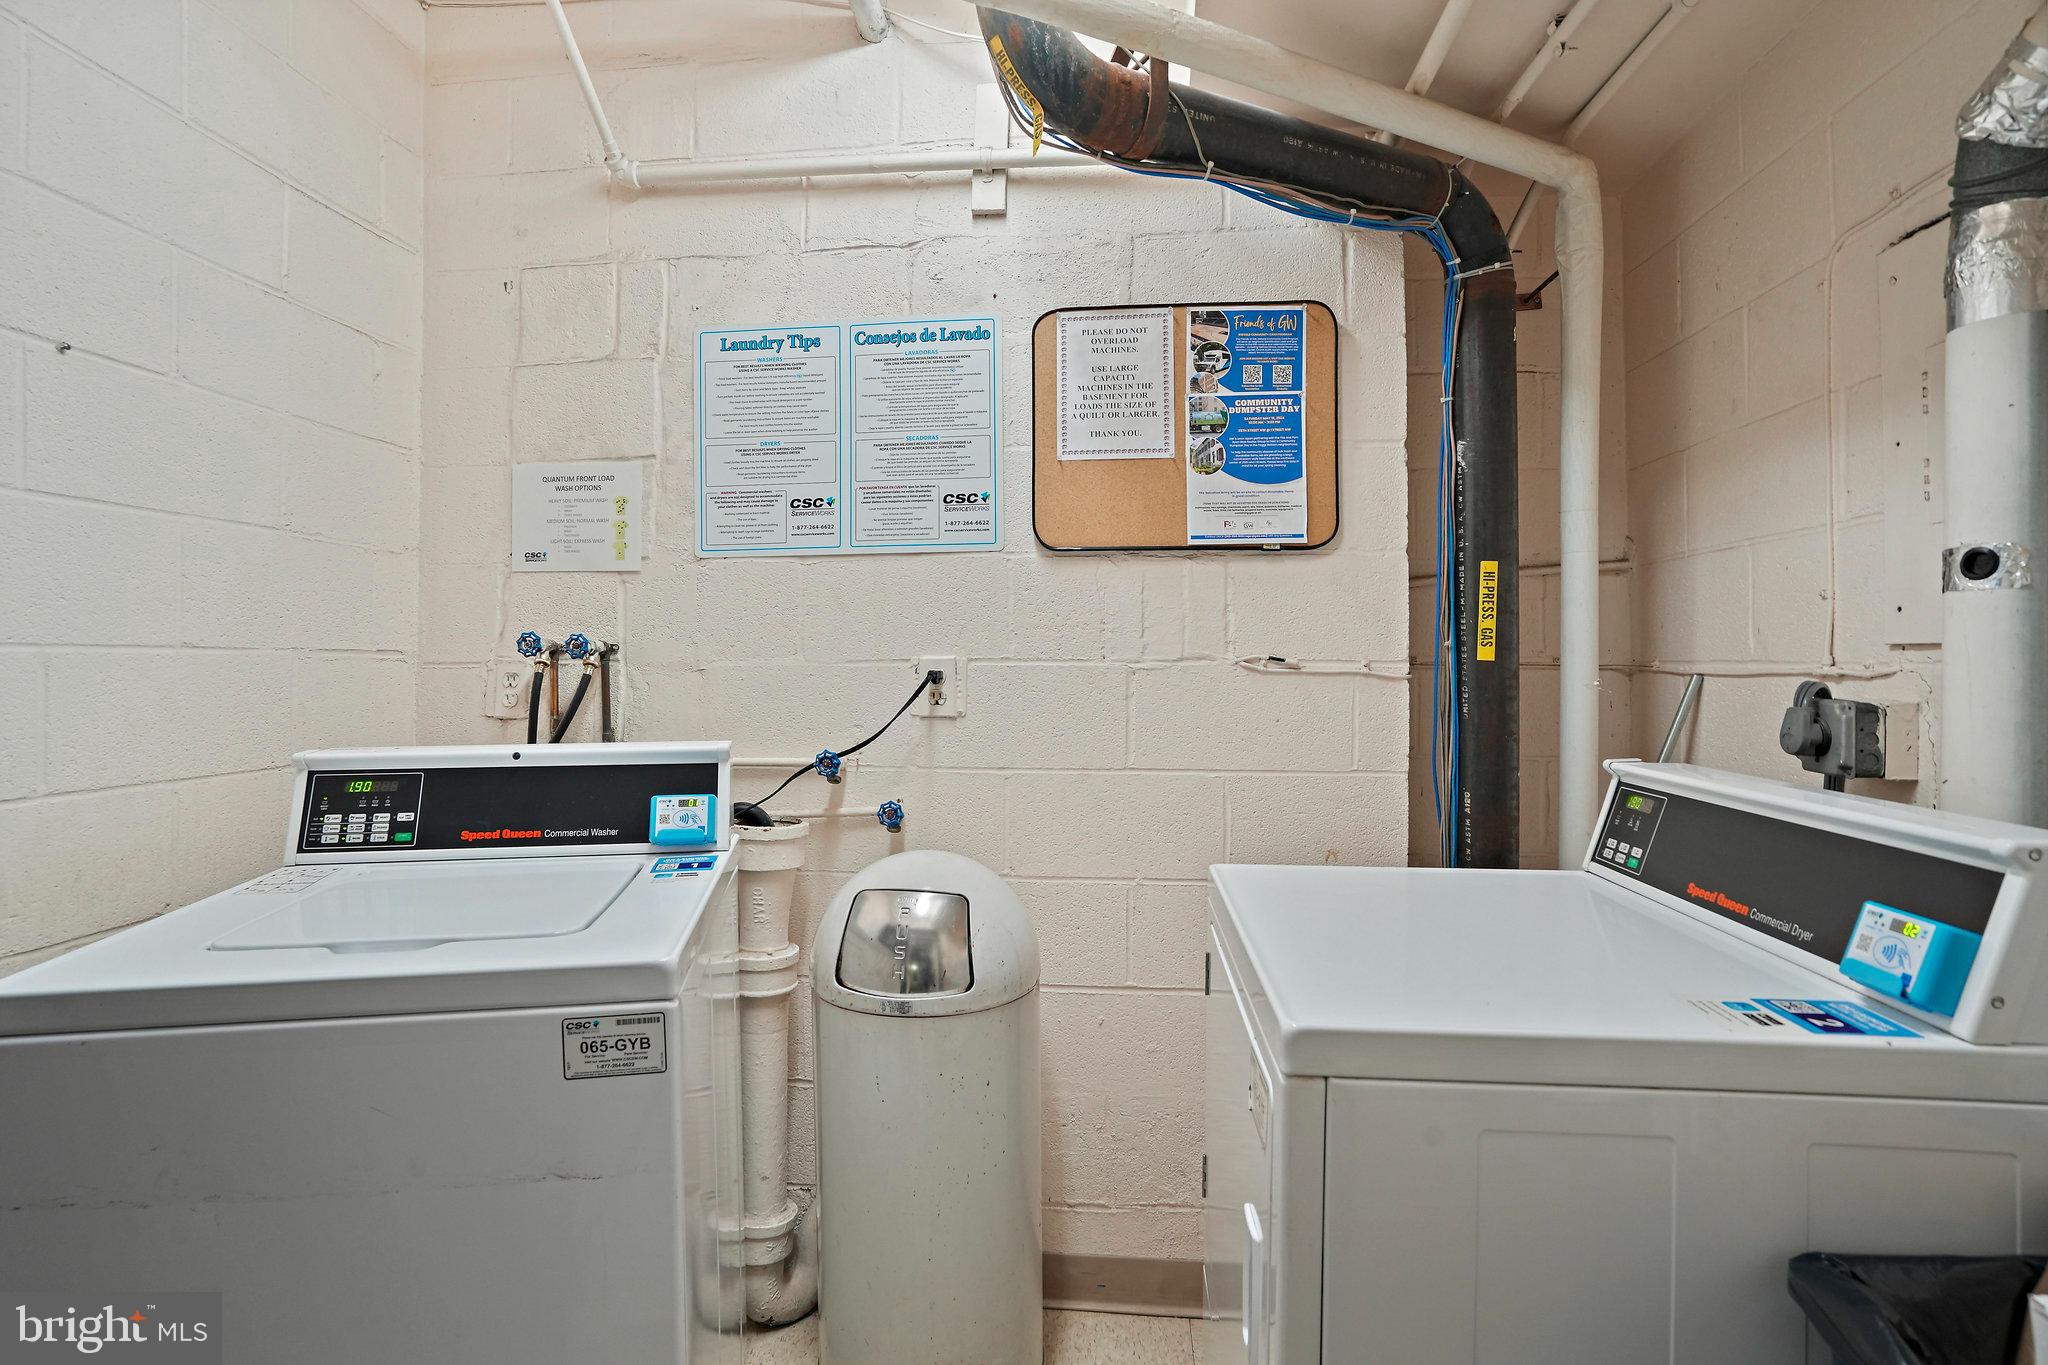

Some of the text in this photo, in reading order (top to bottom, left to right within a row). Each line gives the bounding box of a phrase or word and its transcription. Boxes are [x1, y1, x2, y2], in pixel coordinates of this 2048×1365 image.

[1186, 108, 1216, 123] UNITE
[1234, 315, 1297, 331] Friends of GW
[720, 334, 821, 353] Laundry Tips
[854, 326, 990, 347] Consejos de Lavado
[790, 498, 824, 508] CSC
[943, 493, 978, 504] CSC
[1459, 552, 1464, 561] IN
[1480, 571, 1495, 647] HI-PRESS. GAS
[460, 828, 619, 841] Speed Queen Commercial Washer
[1687, 882, 1814, 941] Speed Queen Commercial Dryer
[566, 1021, 591, 1030] CSC
[580, 1037, 651, 1054] 065-GYB
